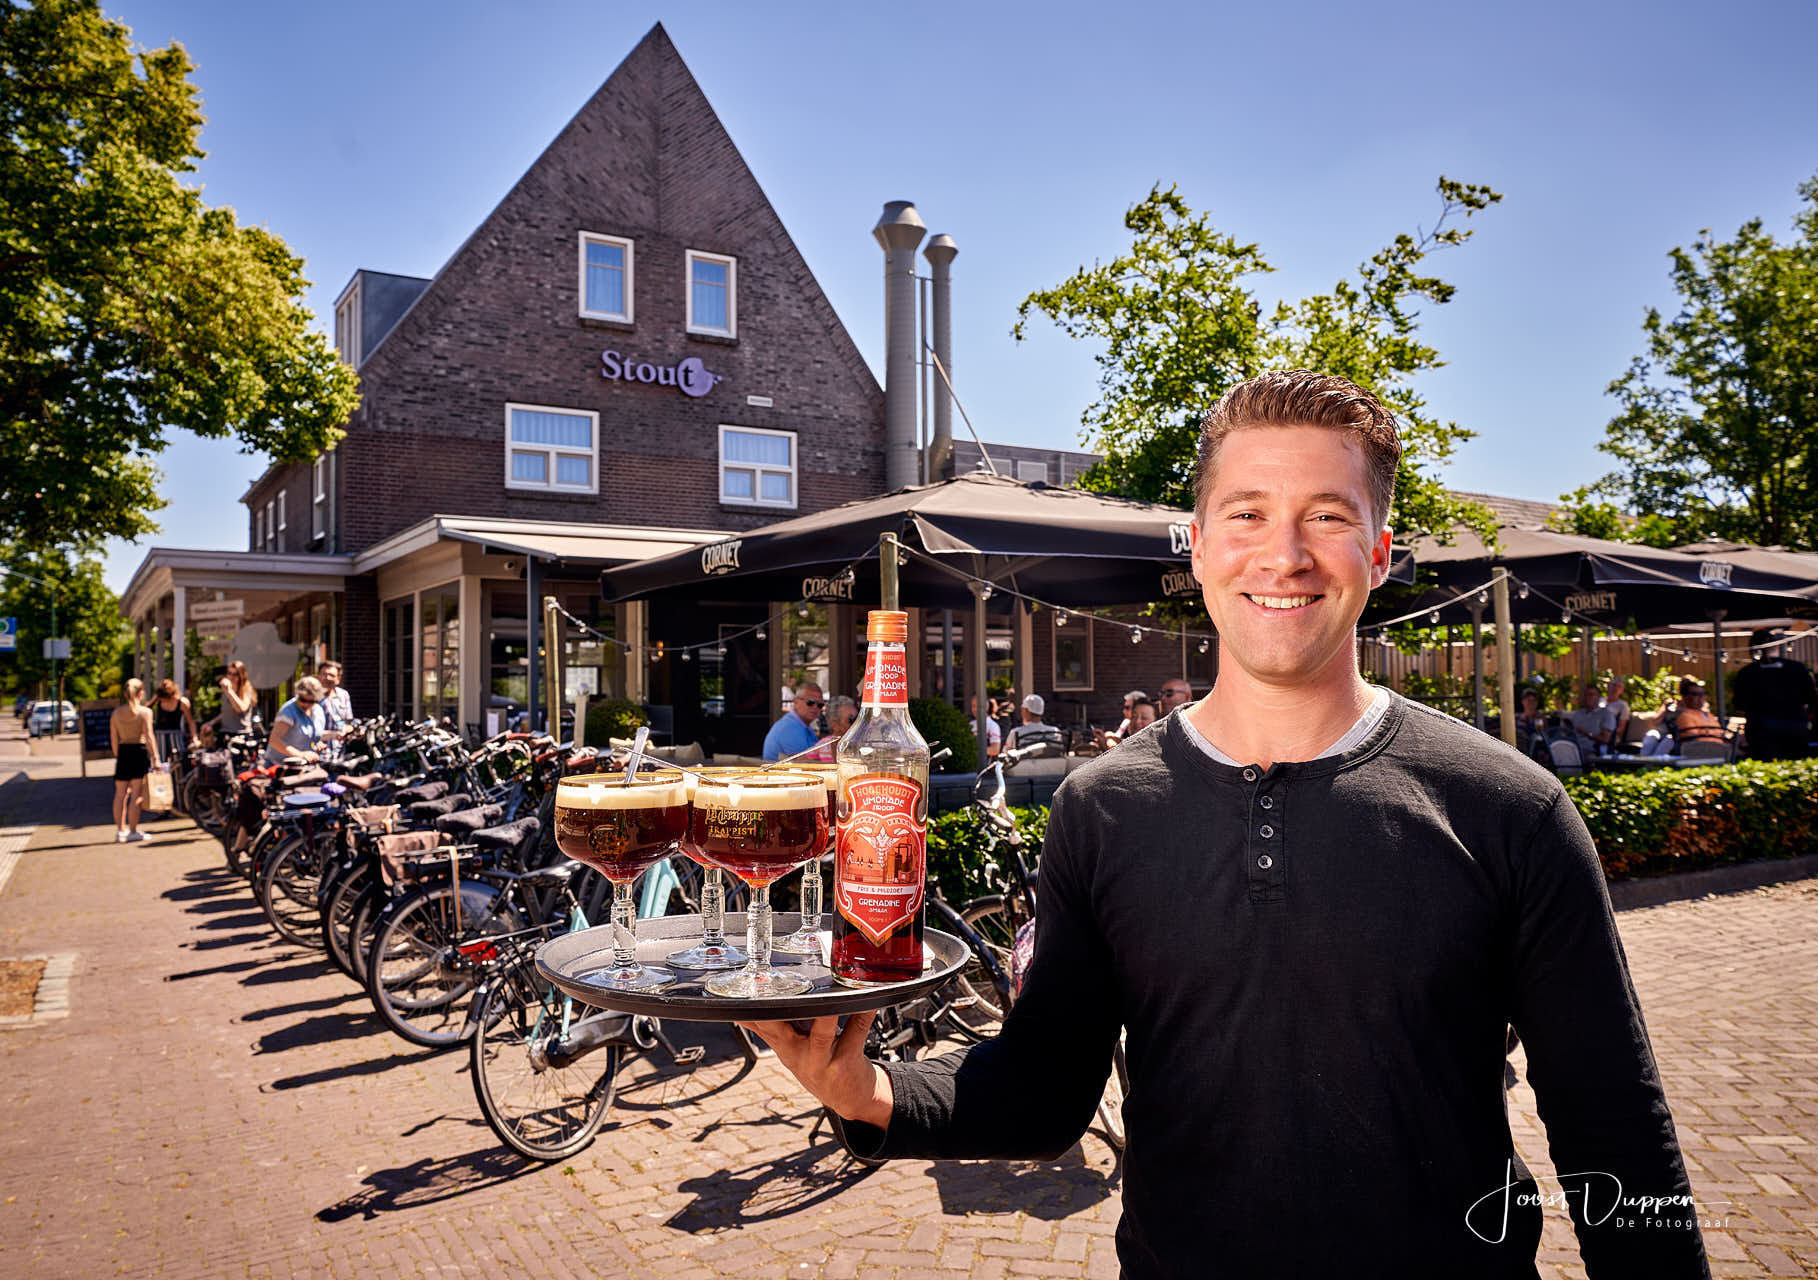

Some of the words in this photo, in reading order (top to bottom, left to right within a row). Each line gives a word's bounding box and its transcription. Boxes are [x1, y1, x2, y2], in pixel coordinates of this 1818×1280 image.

[601, 350, 696, 388] Stout
[702, 540, 742, 574] CORNET
[802, 578, 855, 600] CORNET
[1565, 592, 1617, 612] CORNET
[858, 897, 901, 907] GRENADINE
